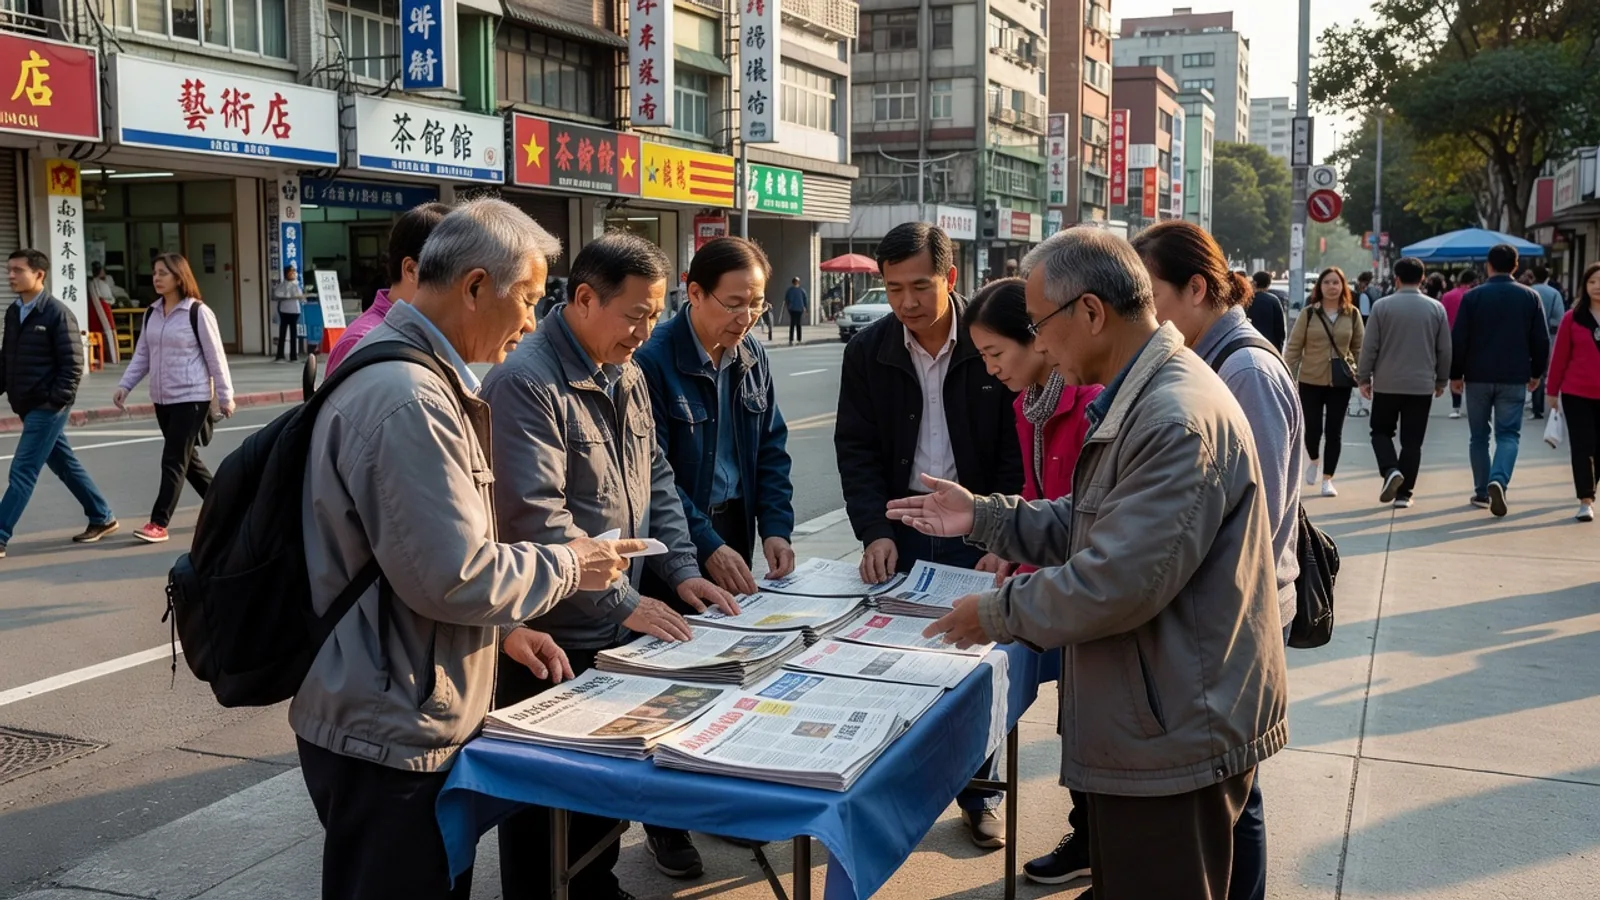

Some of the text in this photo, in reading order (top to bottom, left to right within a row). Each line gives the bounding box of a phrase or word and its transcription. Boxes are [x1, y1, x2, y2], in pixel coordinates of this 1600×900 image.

[10, 50, 53, 107] 店
[177, 78, 292, 140] 藝術店
[390, 112, 474, 162] 茶館館
